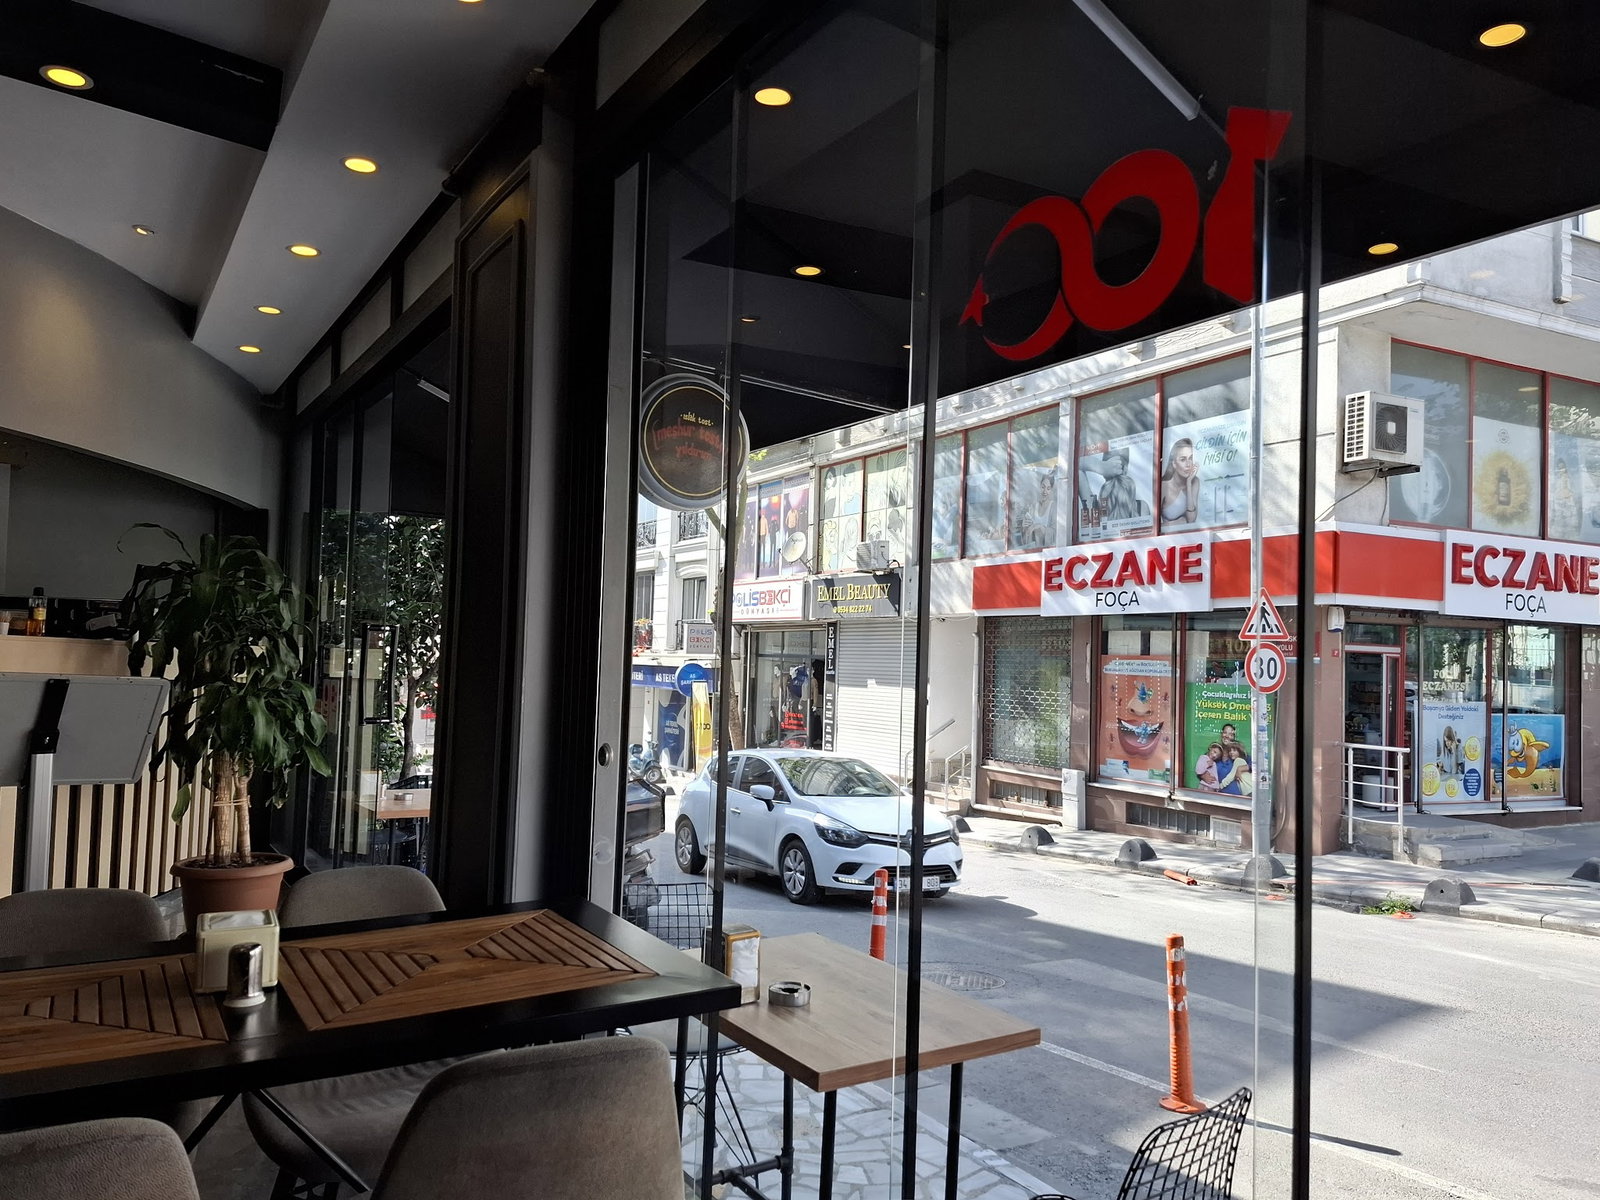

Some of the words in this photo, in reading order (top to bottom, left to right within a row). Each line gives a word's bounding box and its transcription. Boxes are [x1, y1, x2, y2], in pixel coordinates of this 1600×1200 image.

[698, 416, 711, 426] tost
[1195, 433, 1226, 451] CİLDİN
[1227, 429, 1248, 447] İÇİN
[1203, 449, 1226, 466] İYİSİ
[1044, 542, 1203, 591] ECZANE
[1452, 542, 1600, 595] ECZANE
[817, 585, 846, 602] EMEL
[848, 583, 890, 601] BEAUTY
[1095, 591, 1140, 612] FOÇA
[1505, 593, 1547, 617] FOÇA
[827, 627, 836, 669] EMEL
[1254, 656, 1277, 680] 30
[1202, 690, 1247, 700] Çocuklarınız
[1422, 681, 1467, 691] ECZANES
[1196, 700, 1228, 709] Yüksek
[1223, 711, 1247, 721] Balık
